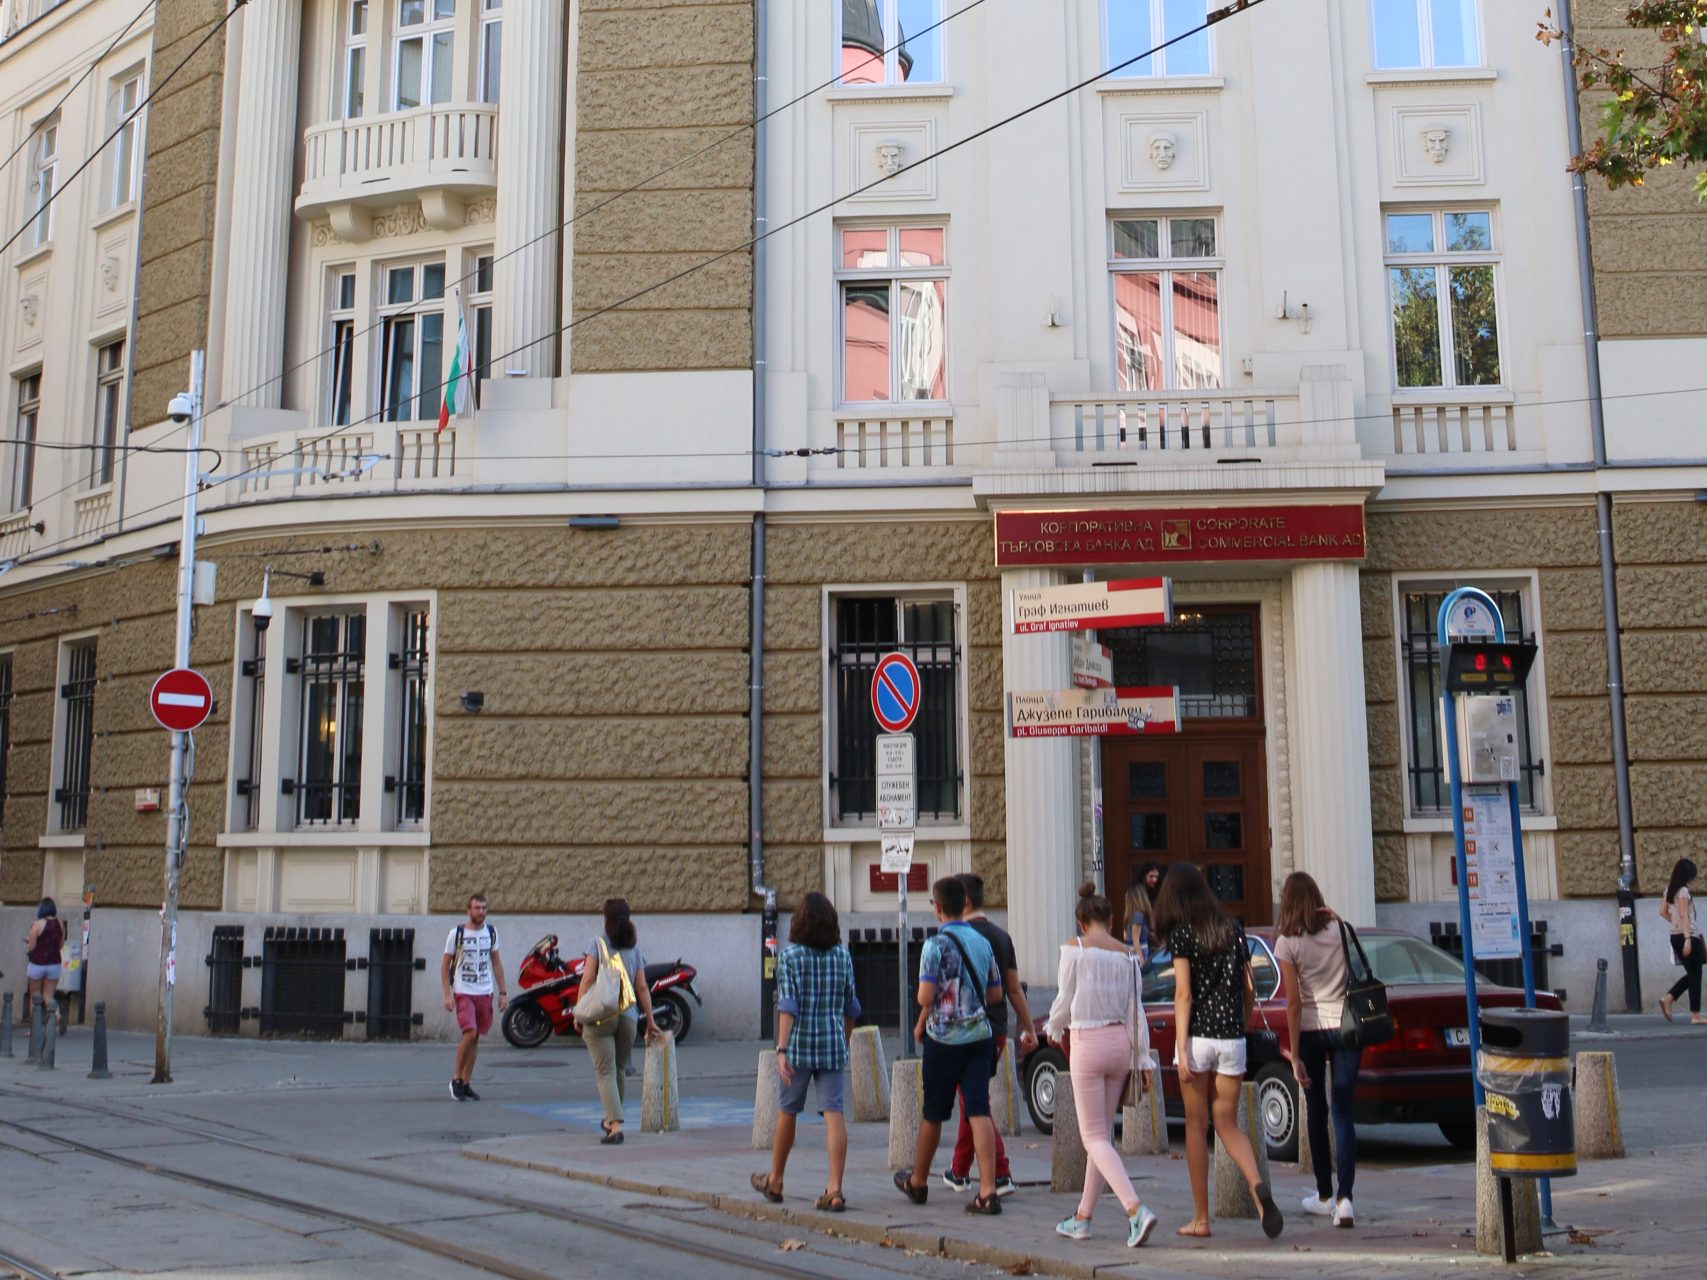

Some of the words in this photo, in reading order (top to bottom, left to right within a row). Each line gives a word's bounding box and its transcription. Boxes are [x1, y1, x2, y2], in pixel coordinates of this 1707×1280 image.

[1040, 520, 1153, 534] КОРПОРАТИВНА
[1196, 517, 1286, 531] CORPORATE
[1000, 539, 1081, 554] ТЪРГОВСКА
[1085, 539, 1131, 551] БАНКА
[1135, 538, 1155, 553] АД
[1199, 535, 1296, 550] COMMERCIAL
[1300, 533, 1338, 546] BANK
[1342, 533, 1362, 546] AD
[1018, 593, 1042, 601] Улица
[1018, 604, 1046, 619] Граф
[1050, 599, 1109, 615] Игнатиев
[1019, 623, 1029, 632] ul.
[1030, 622, 1046, 631] Graf
[1048, 620, 1079, 632] Ignatiev
[1016, 706, 1073, 723] Джузепе
[1017, 727, 1028, 736] pl.
[1029, 725, 1068, 736] Giuseppe
[1069, 723, 1108, 735] Garibaldi
[881, 781, 910, 790] СЛУЖЕБЕН
[880, 793, 911, 801] АБОНАМЕНТ
